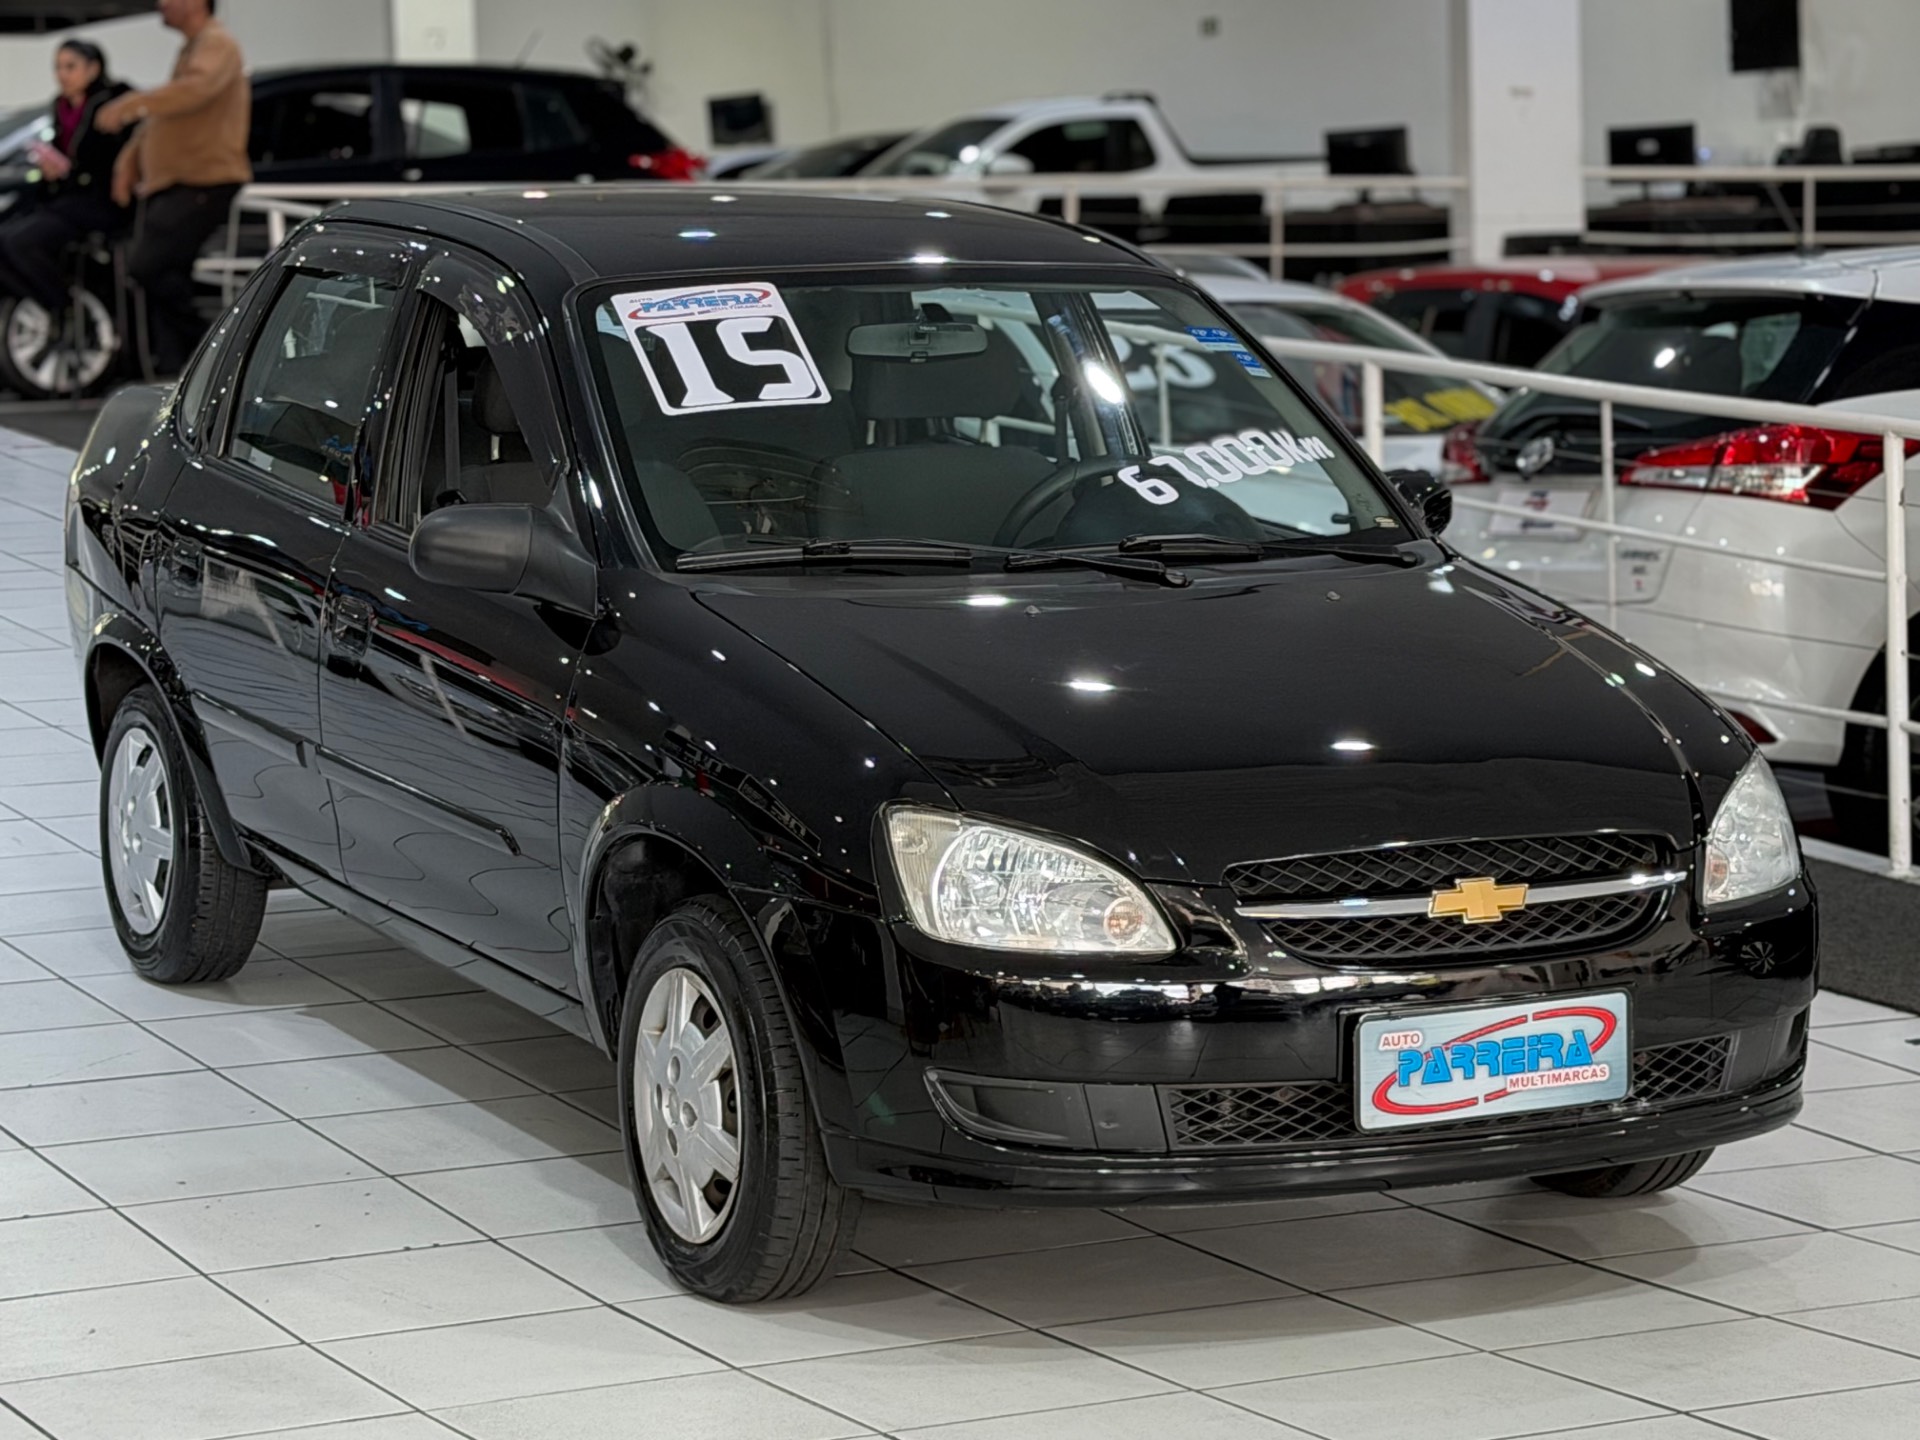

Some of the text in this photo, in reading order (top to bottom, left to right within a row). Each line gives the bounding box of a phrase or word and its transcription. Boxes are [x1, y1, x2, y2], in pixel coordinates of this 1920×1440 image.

[646, 316, 817, 407] 15
[1381, 1032, 1421, 1048] AUTO
[1397, 1028, 1594, 1088] PARREIRA
[1508, 1066, 1608, 1089] MULTIMARCAS
